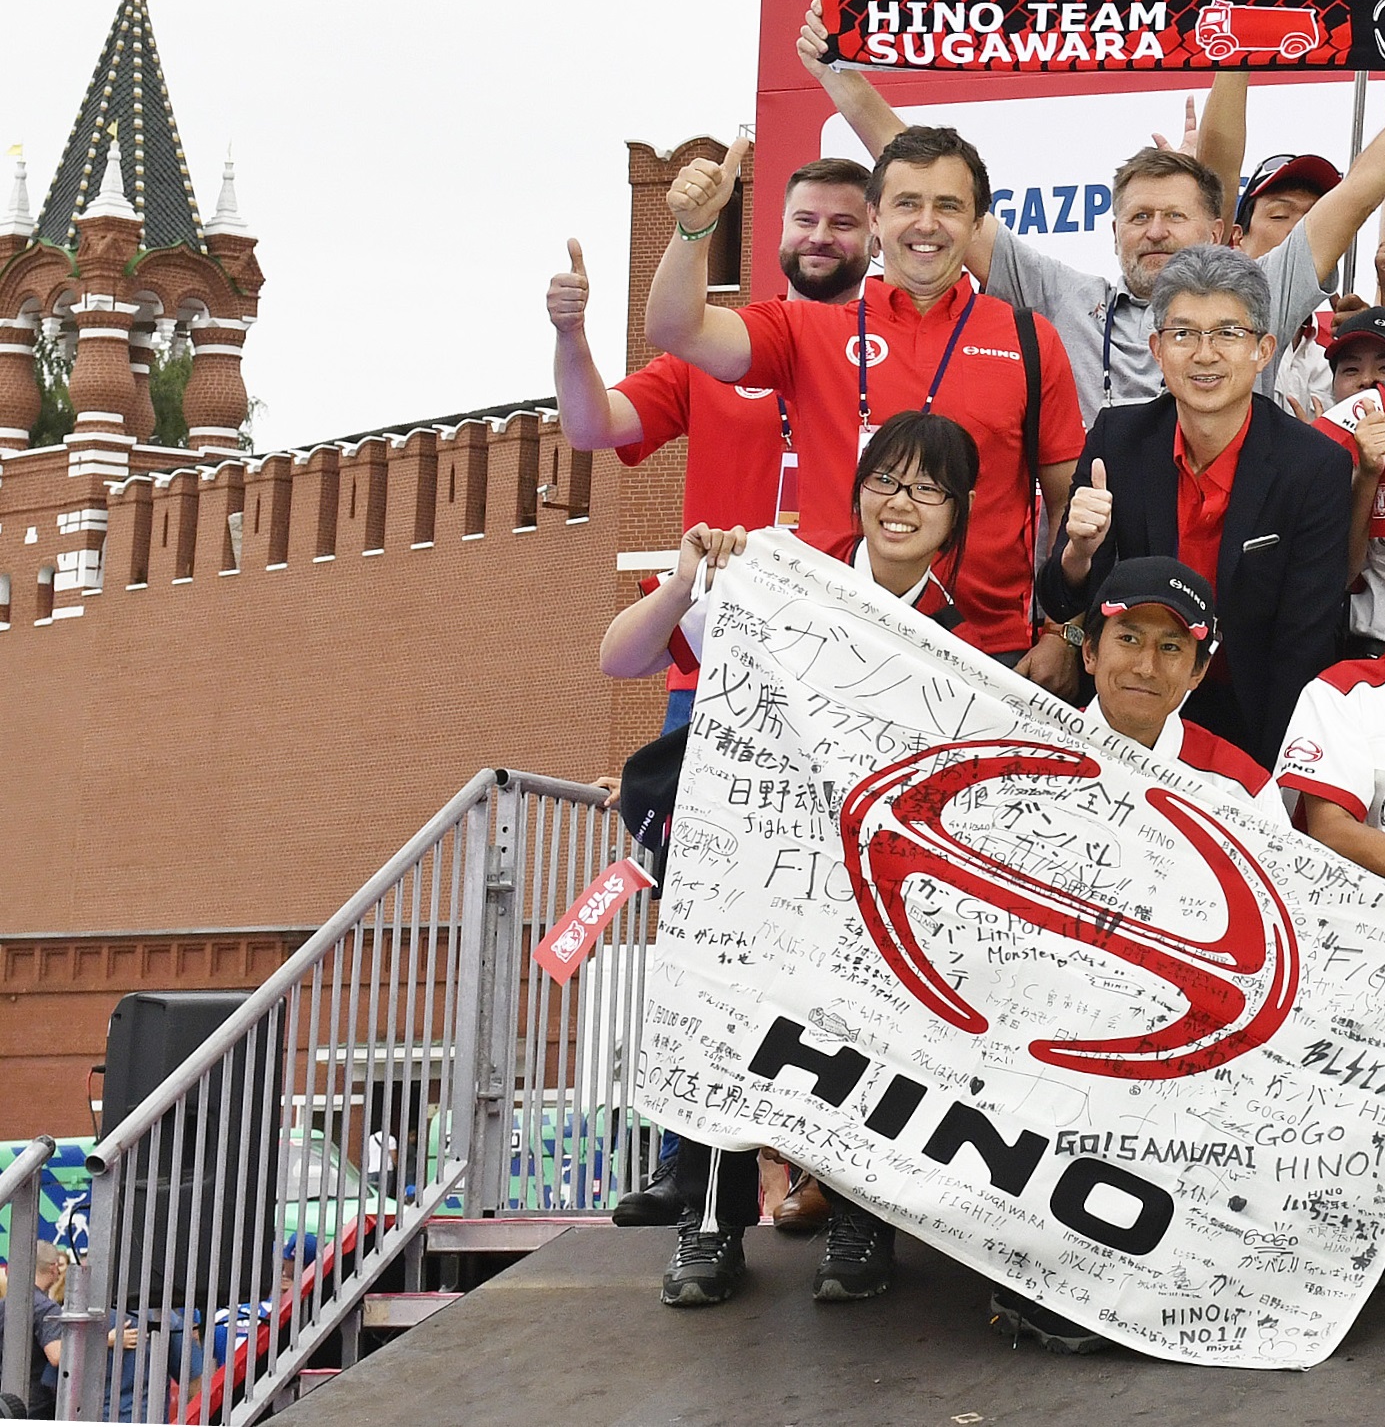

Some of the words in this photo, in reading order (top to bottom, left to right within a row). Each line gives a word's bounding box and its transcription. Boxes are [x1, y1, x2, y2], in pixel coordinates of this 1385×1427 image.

[865, 32, 1166, 65] SUGAWARA
[990, 184, 1113, 235] GAZP
[979, 348, 1021, 361] HINO
[1181, 582, 1207, 610] HINO
[639, 808, 656, 837] HINO
[577, 872, 621, 922] SILK
[586, 878, 626, 926] WAY
[747, 1014, 1175, 1257] HINO
[937, 1174, 974, 1193] TEAM
[975, 1188, 1046, 1231] SUGAWARA
